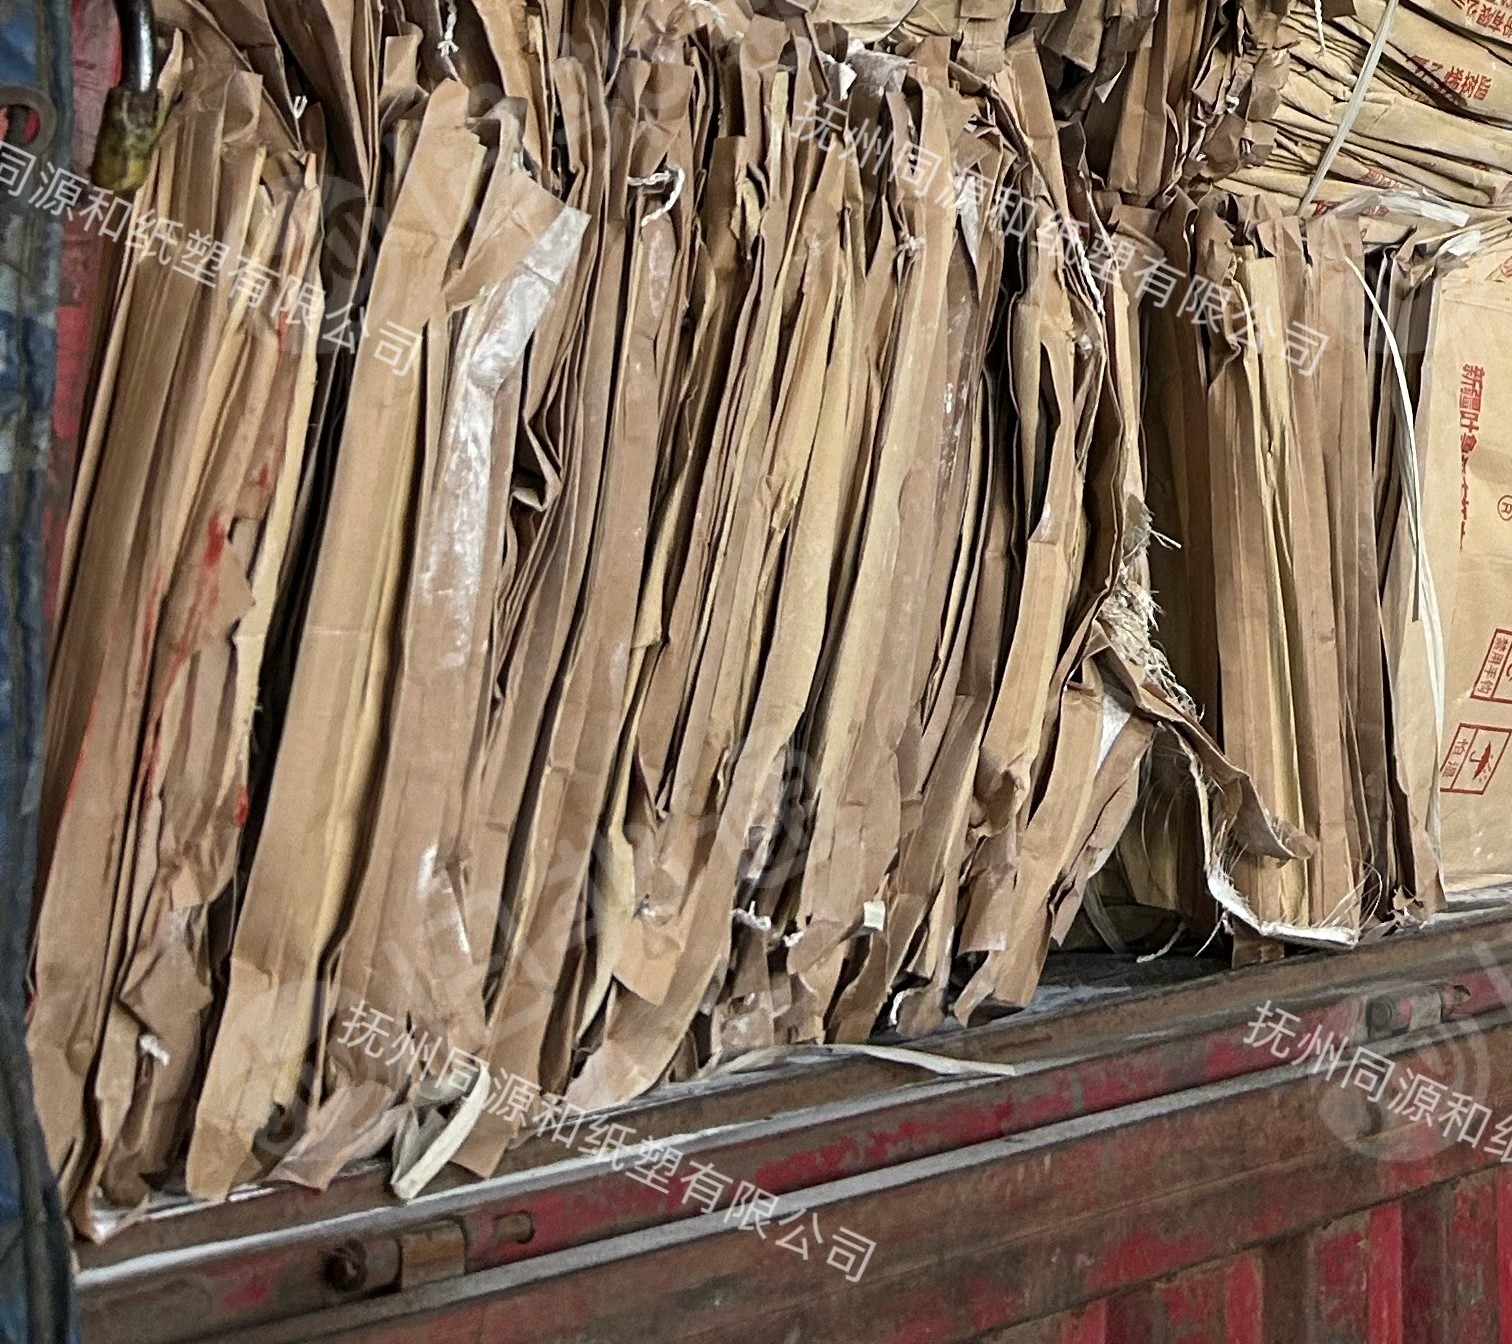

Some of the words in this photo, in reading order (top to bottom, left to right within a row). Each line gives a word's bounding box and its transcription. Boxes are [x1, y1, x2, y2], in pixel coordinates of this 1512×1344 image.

[1476, 636, 1511, 696] 禁用手钩
[1444, 737, 1470, 780] 怕湿
